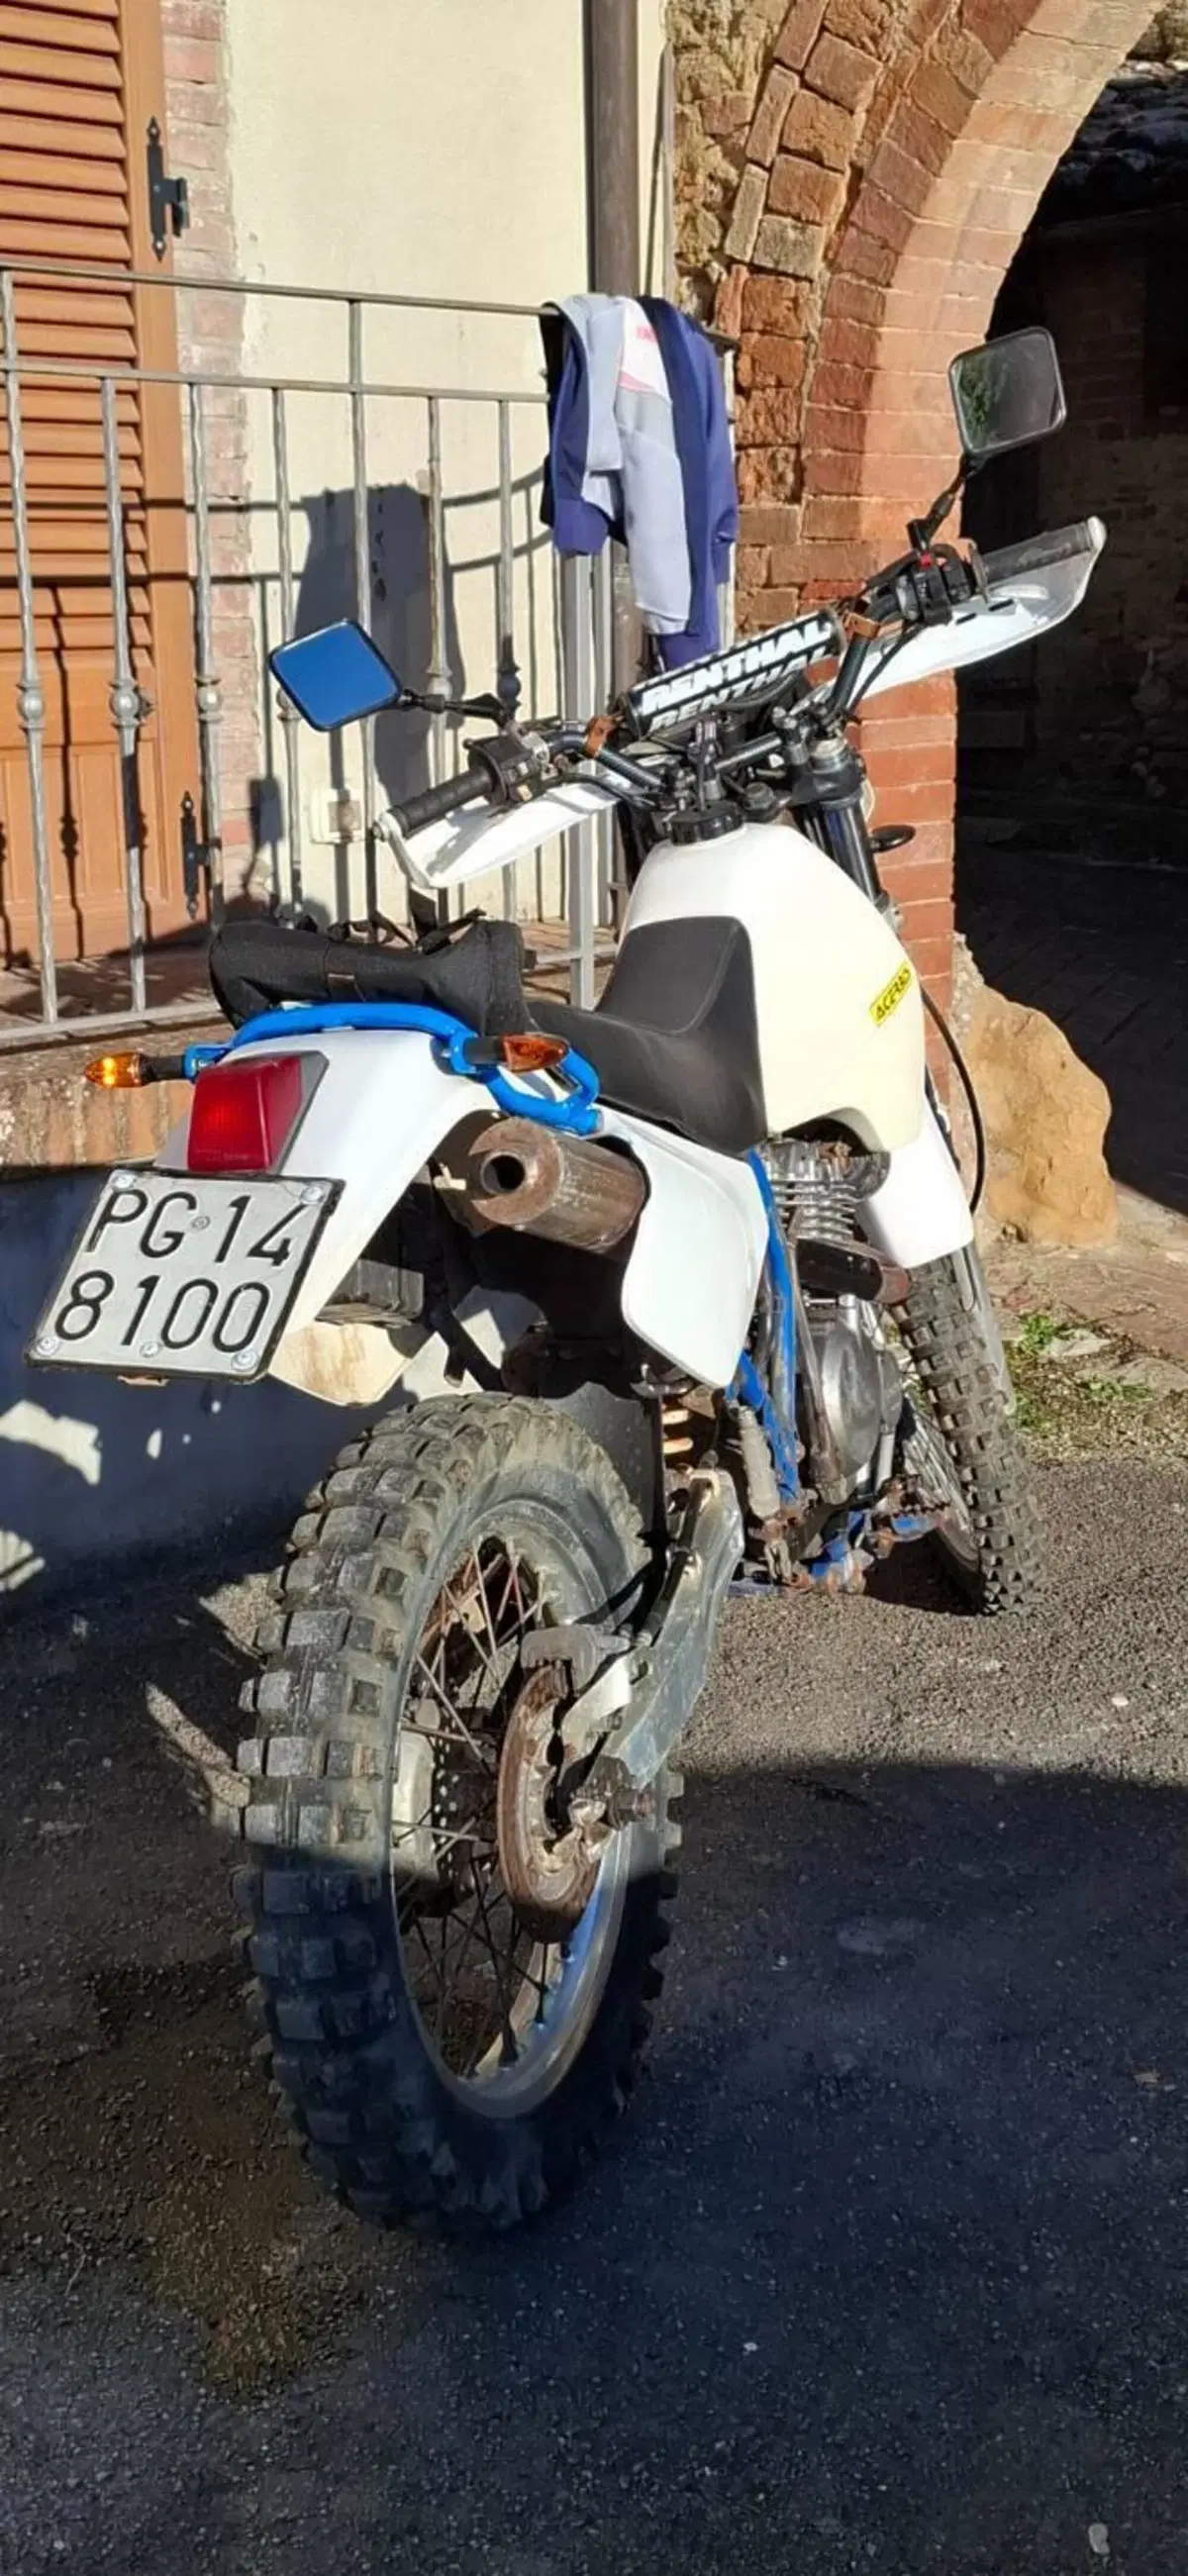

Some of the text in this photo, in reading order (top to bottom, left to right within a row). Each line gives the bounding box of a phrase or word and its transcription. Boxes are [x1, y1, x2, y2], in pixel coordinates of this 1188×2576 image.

[642, 621, 833, 712] RENTHAL
[648, 646, 827, 734] RENTHAL
[85, 1187, 307, 1266] PG 14
[54, 1270, 270, 1353] 8100
